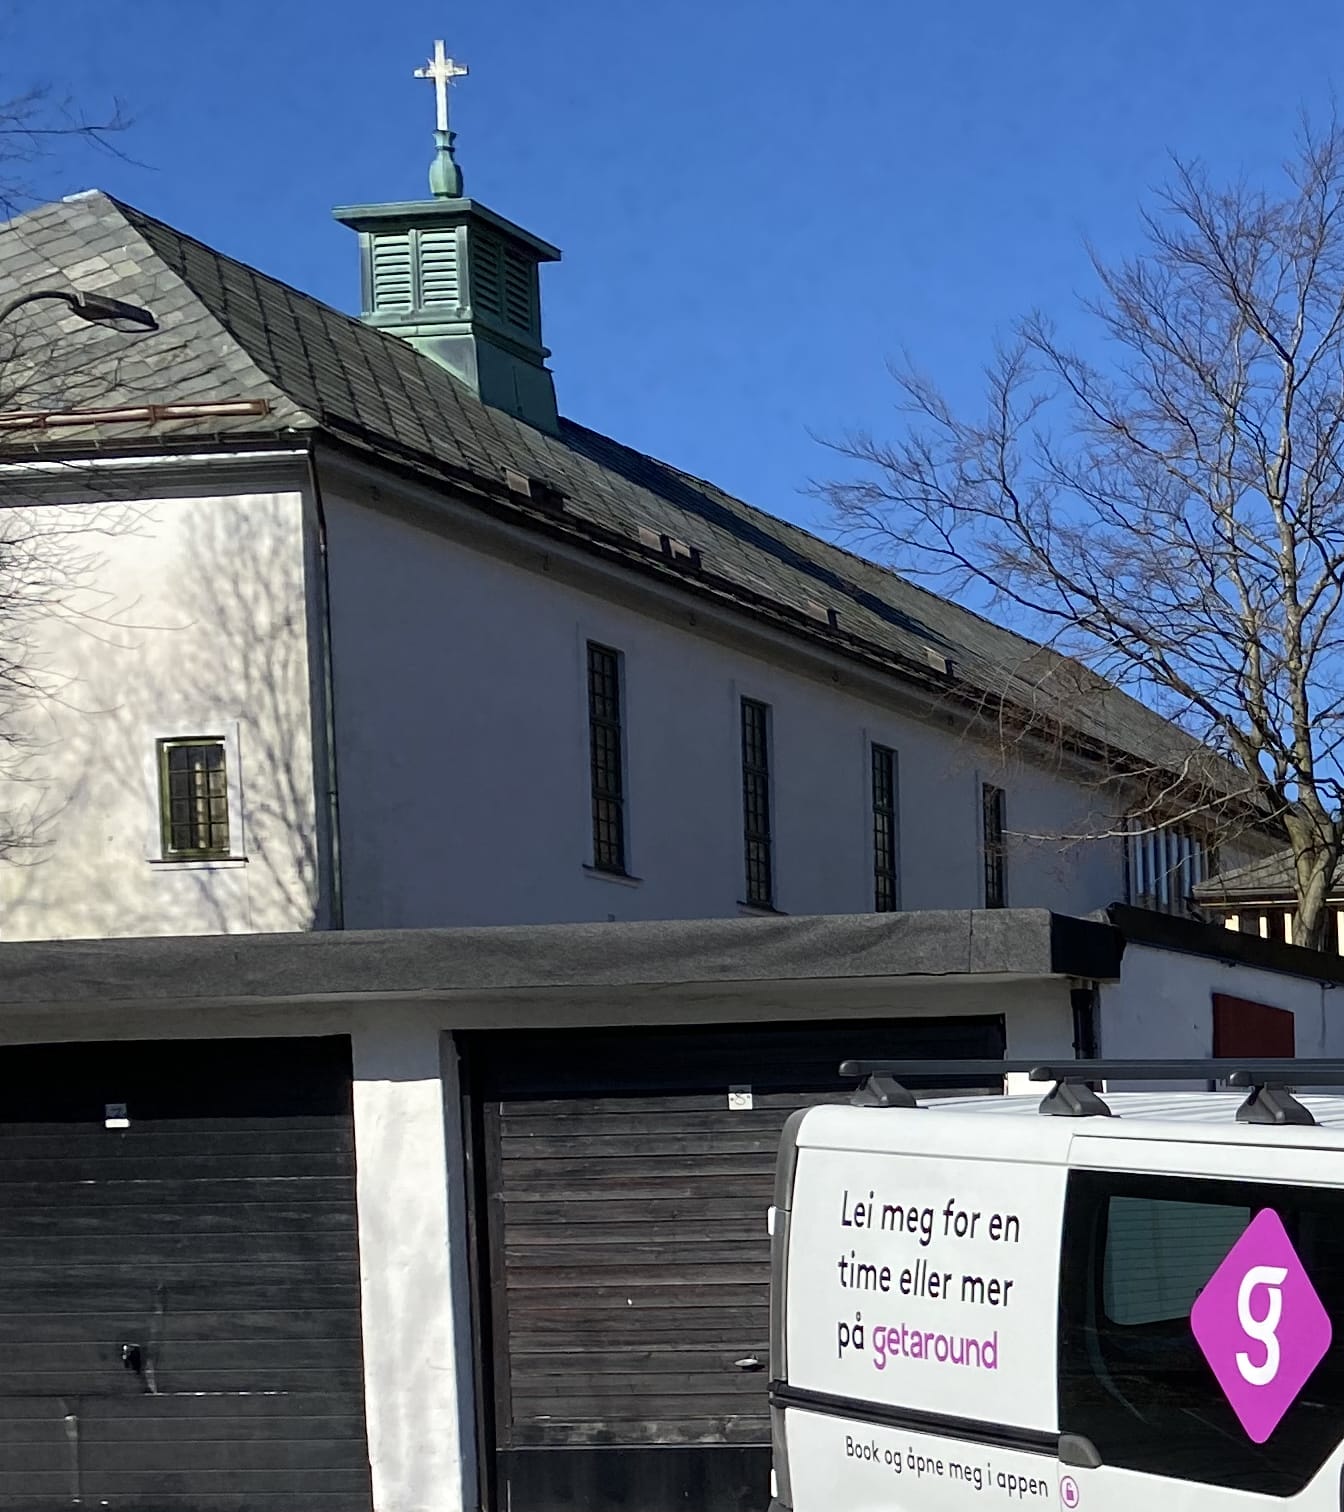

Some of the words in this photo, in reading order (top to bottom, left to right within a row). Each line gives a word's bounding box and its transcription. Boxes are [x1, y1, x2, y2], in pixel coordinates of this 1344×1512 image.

[841, 1190, 874, 1229] Lei
[881, 1204, 934, 1246] meg
[943, 1198, 981, 1239] for
[988, 1213, 1020, 1243] en
[838, 1250, 891, 1292] time
[899, 1258, 953, 1300] eller
[961, 1274, 1014, 1307] mer
[838, 1311, 865, 1359] på
[872, 1322, 998, 1371] getaround
[1235, 1265, 1288, 1386] g
[845, 1435, 880, 1463] Book
[884, 1448, 902, 1474] og
[907, 1446, 944, 1478] åpne
[949, 1461, 983, 1491] meg
[986, 1462, 992, 1486] i
[996, 1471, 1049, 1499] appen
